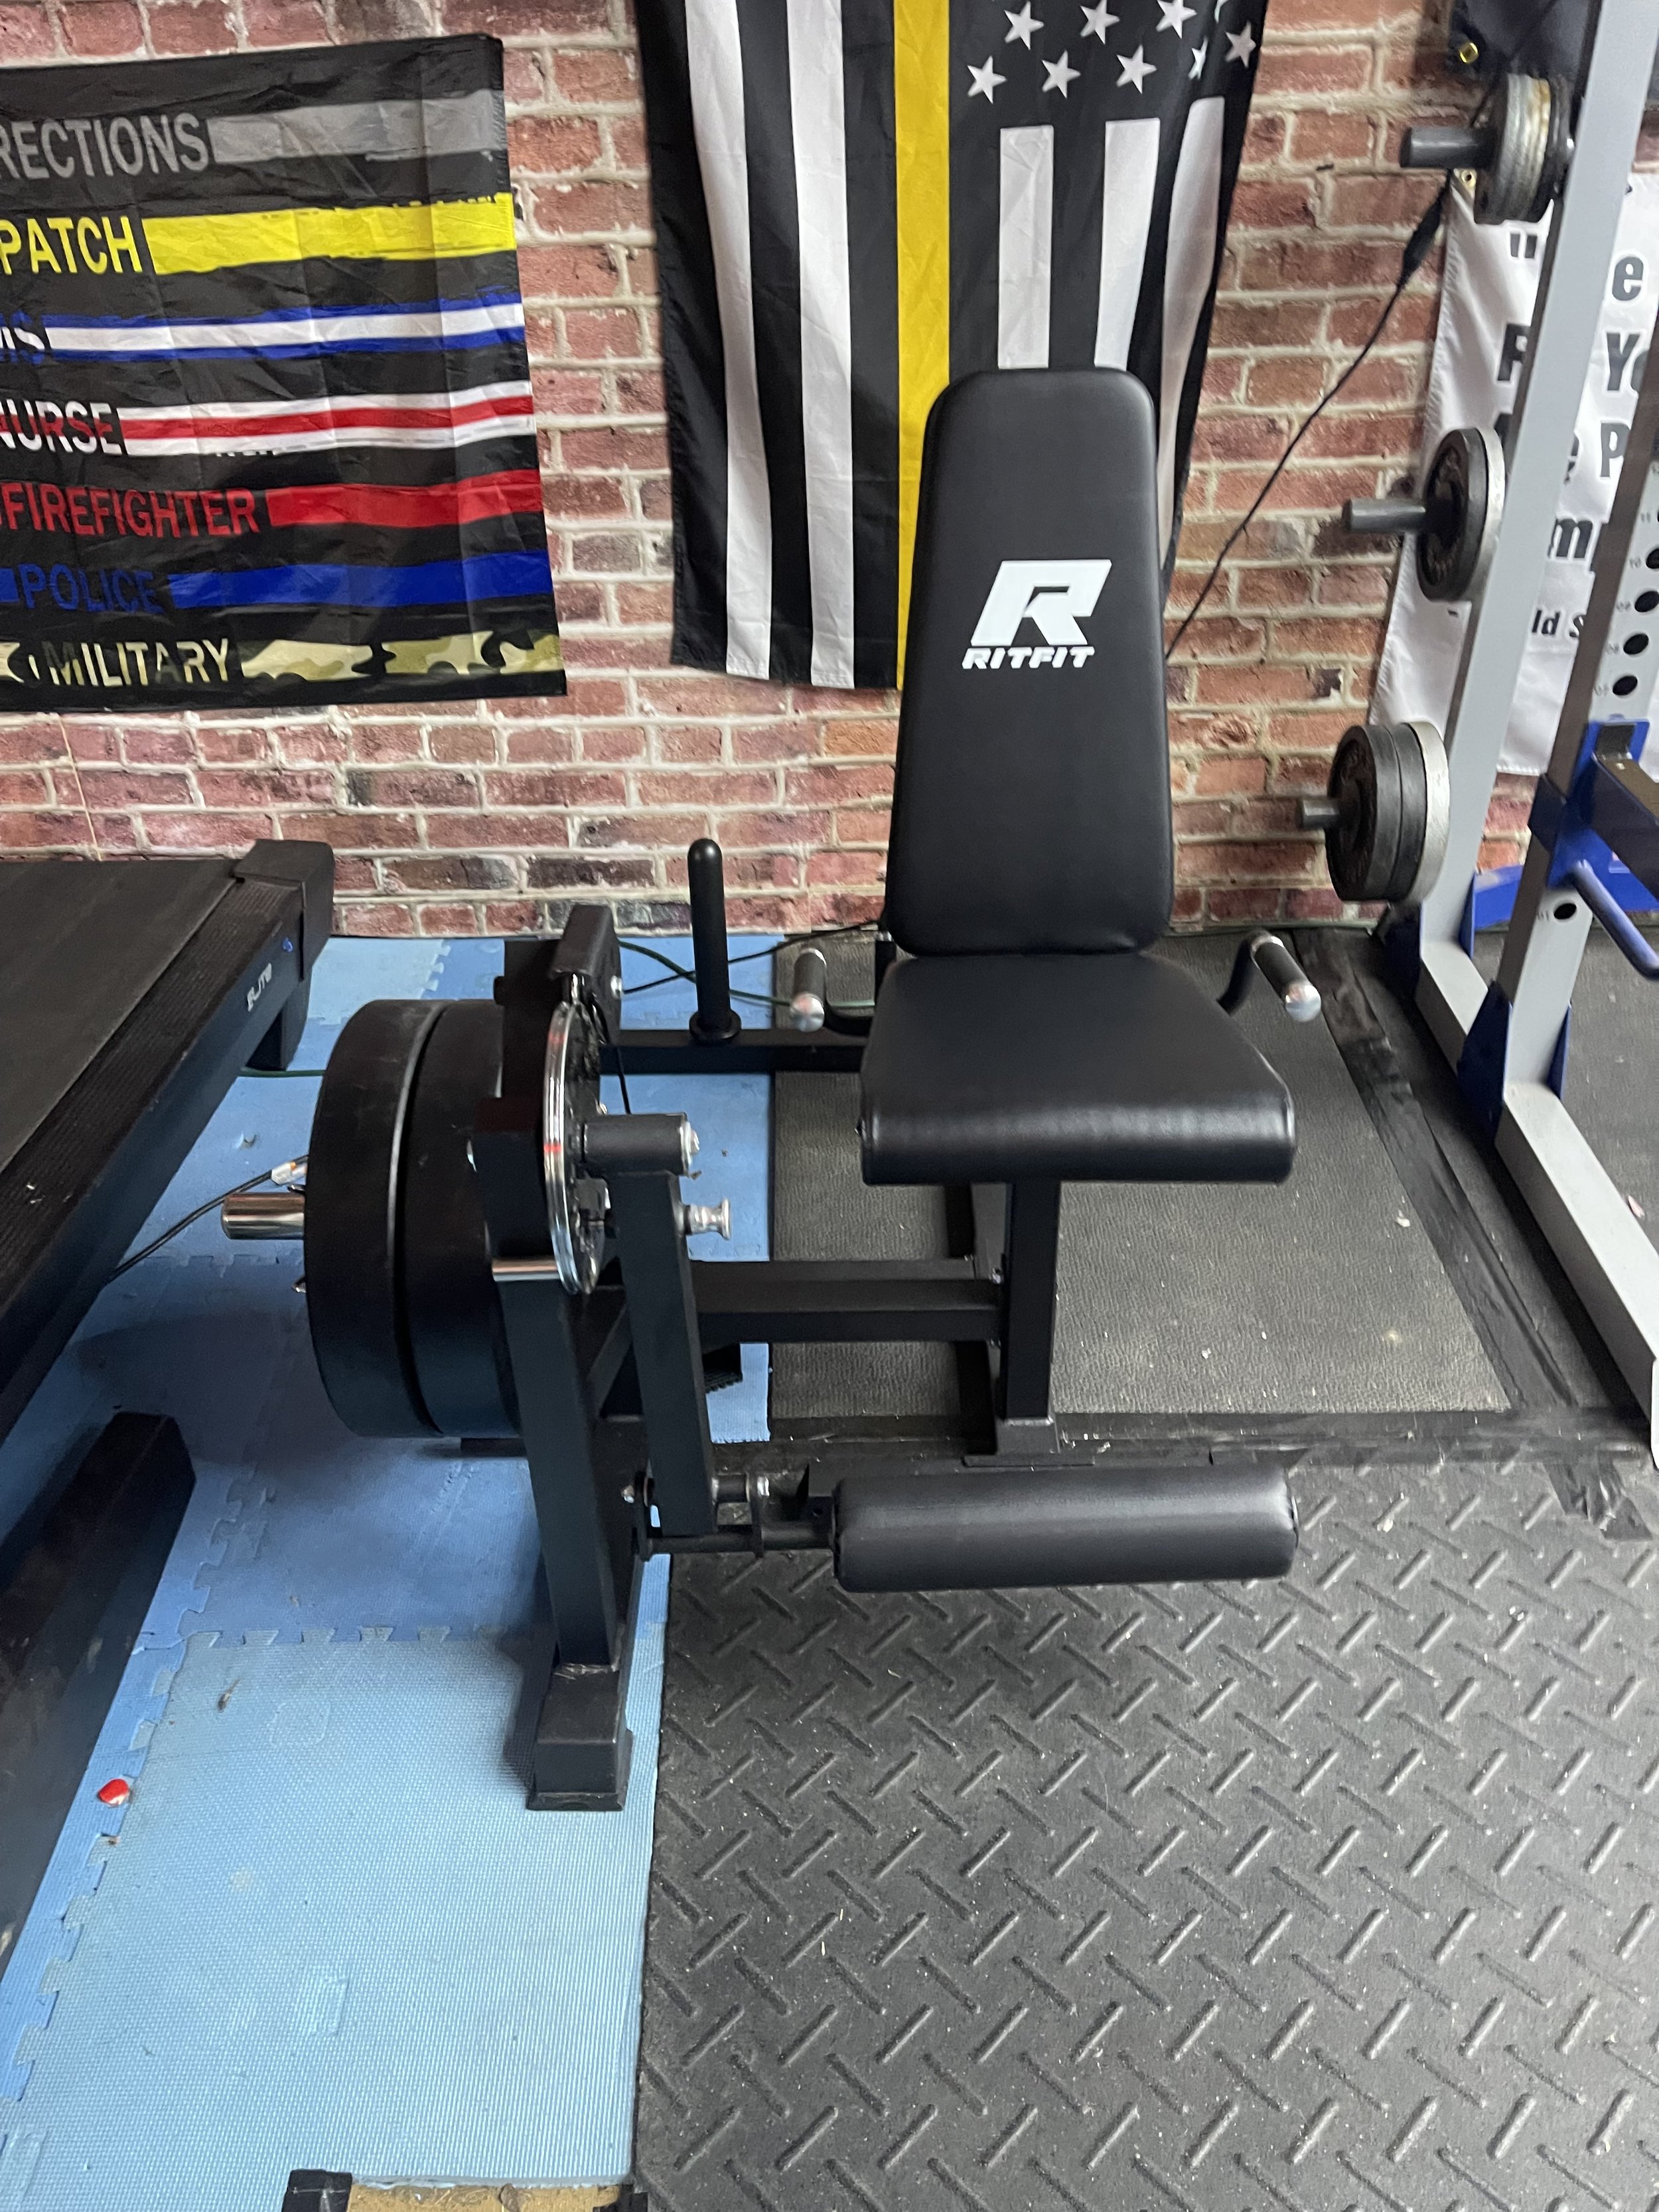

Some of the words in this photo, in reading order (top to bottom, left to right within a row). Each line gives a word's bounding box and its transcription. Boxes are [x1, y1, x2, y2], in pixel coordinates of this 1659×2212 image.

[0, 399, 122, 455] NURSE
[2, 482, 259, 538] FIREFIGHTER
[17, 563, 165, 614] POLICE
[40, 638, 229, 687] MILITARY
[962, 646, 1096, 670] RITFIT
